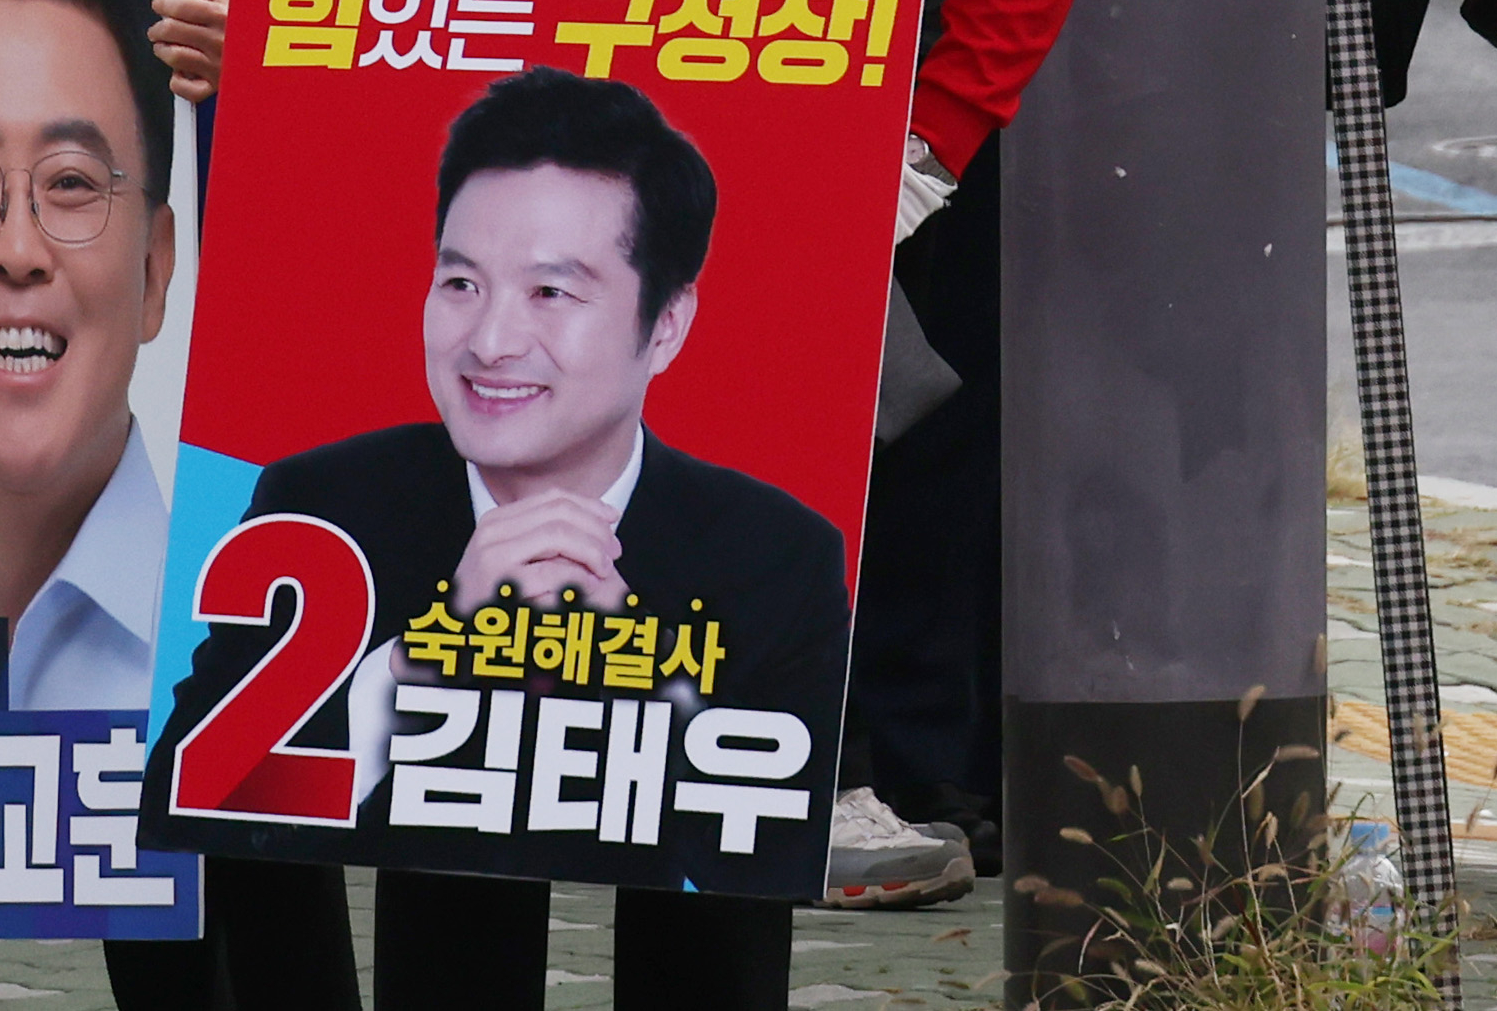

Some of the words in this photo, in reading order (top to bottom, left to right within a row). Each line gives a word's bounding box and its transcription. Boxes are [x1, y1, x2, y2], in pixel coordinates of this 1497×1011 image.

[168, 513, 376, 828] 2
[404, 600, 726, 694] 숙원해결사
[388, 683, 812, 854] 김태우
